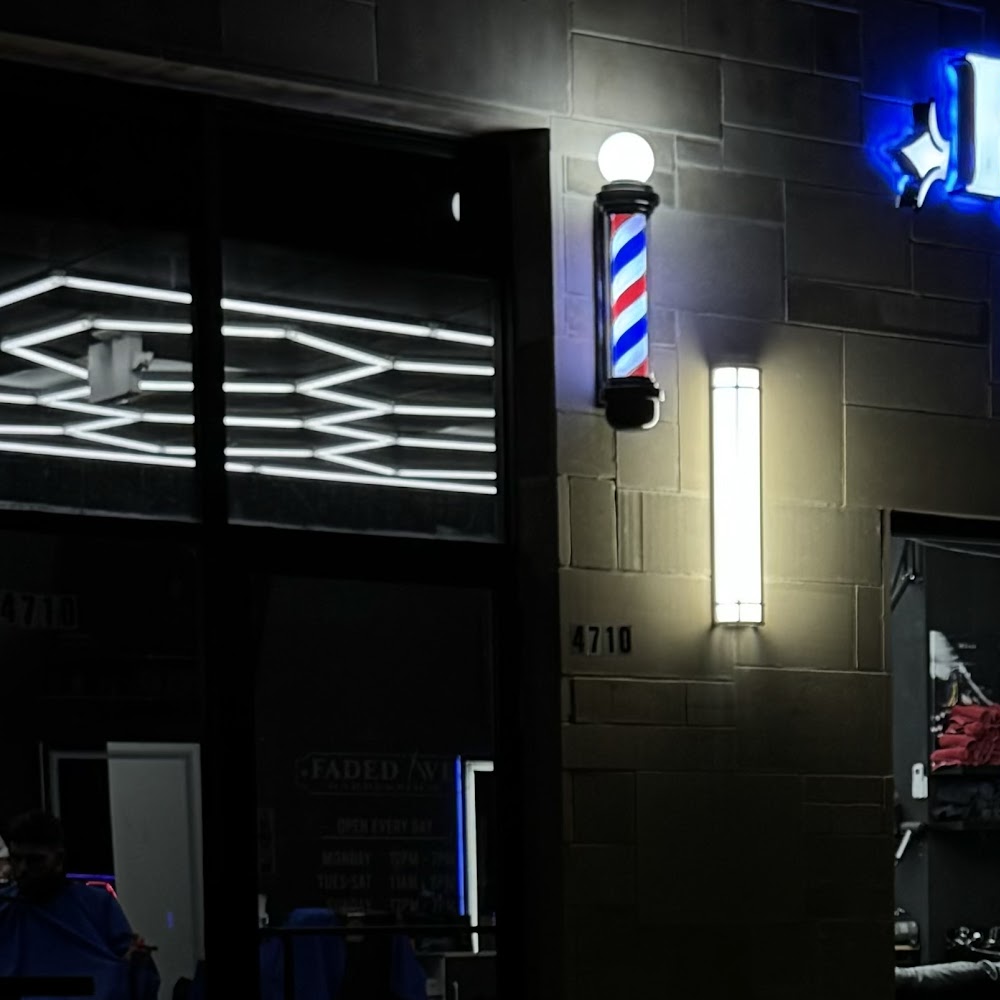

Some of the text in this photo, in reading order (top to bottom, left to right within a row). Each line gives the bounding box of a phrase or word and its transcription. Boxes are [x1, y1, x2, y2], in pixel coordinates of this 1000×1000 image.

[1, 593, 73, 625] 4710
[573, 626, 631, 653] 4710
[311, 758, 399, 780] FADED
